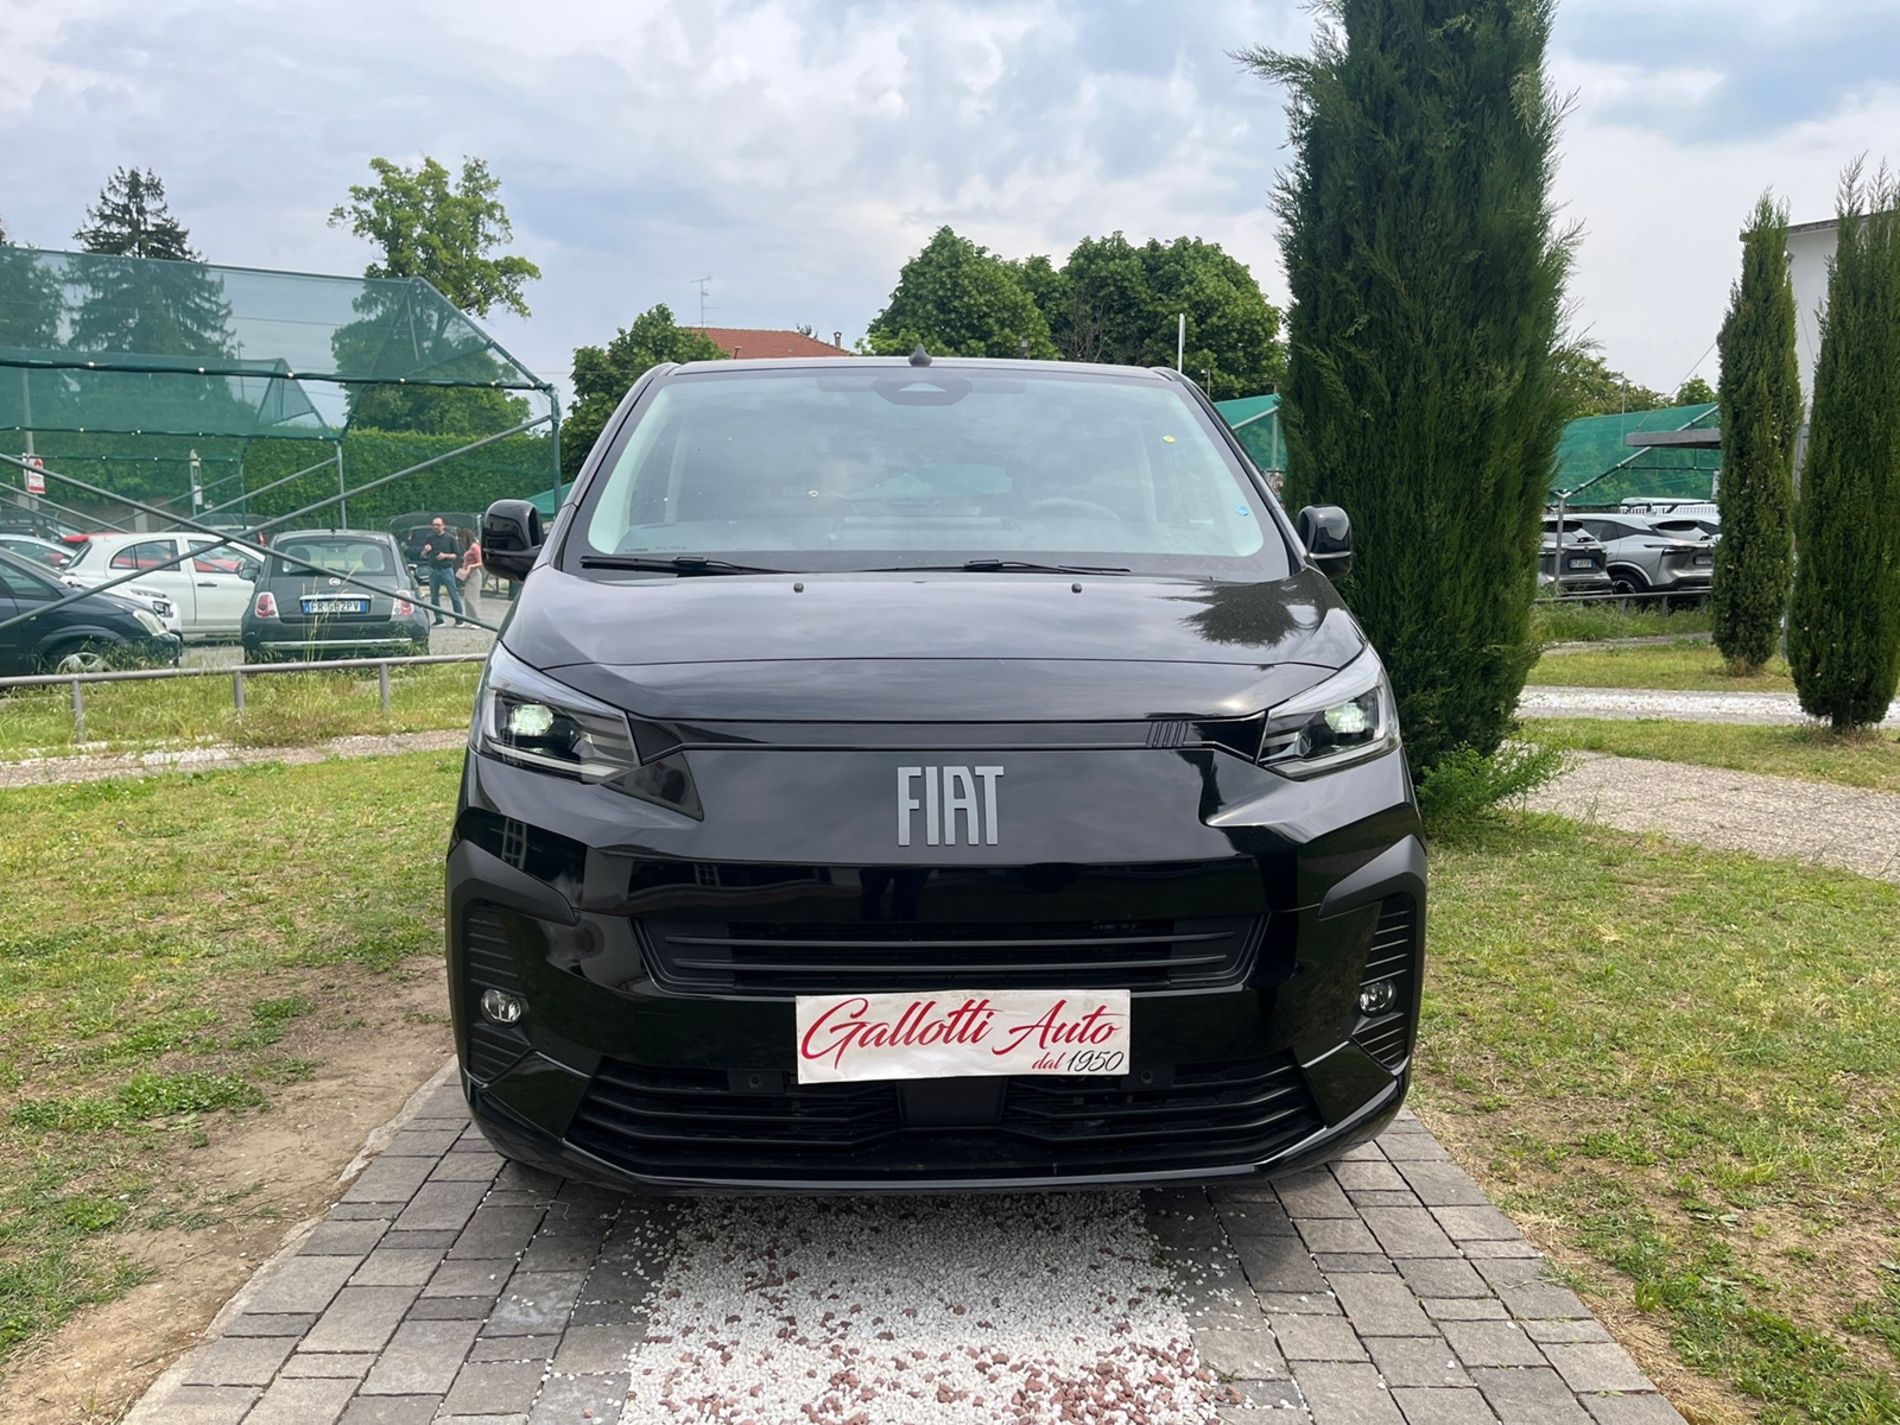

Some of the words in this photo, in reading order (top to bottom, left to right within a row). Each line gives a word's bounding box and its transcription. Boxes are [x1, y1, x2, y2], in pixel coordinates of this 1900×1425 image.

[897, 765, 1005, 846] FIAT
[801, 998, 1000, 1070] Gallotti
[992, 999, 1125, 1056] Auto
[1031, 1051, 1066, 1071] dal
[1066, 1050, 1125, 1073] 1950
